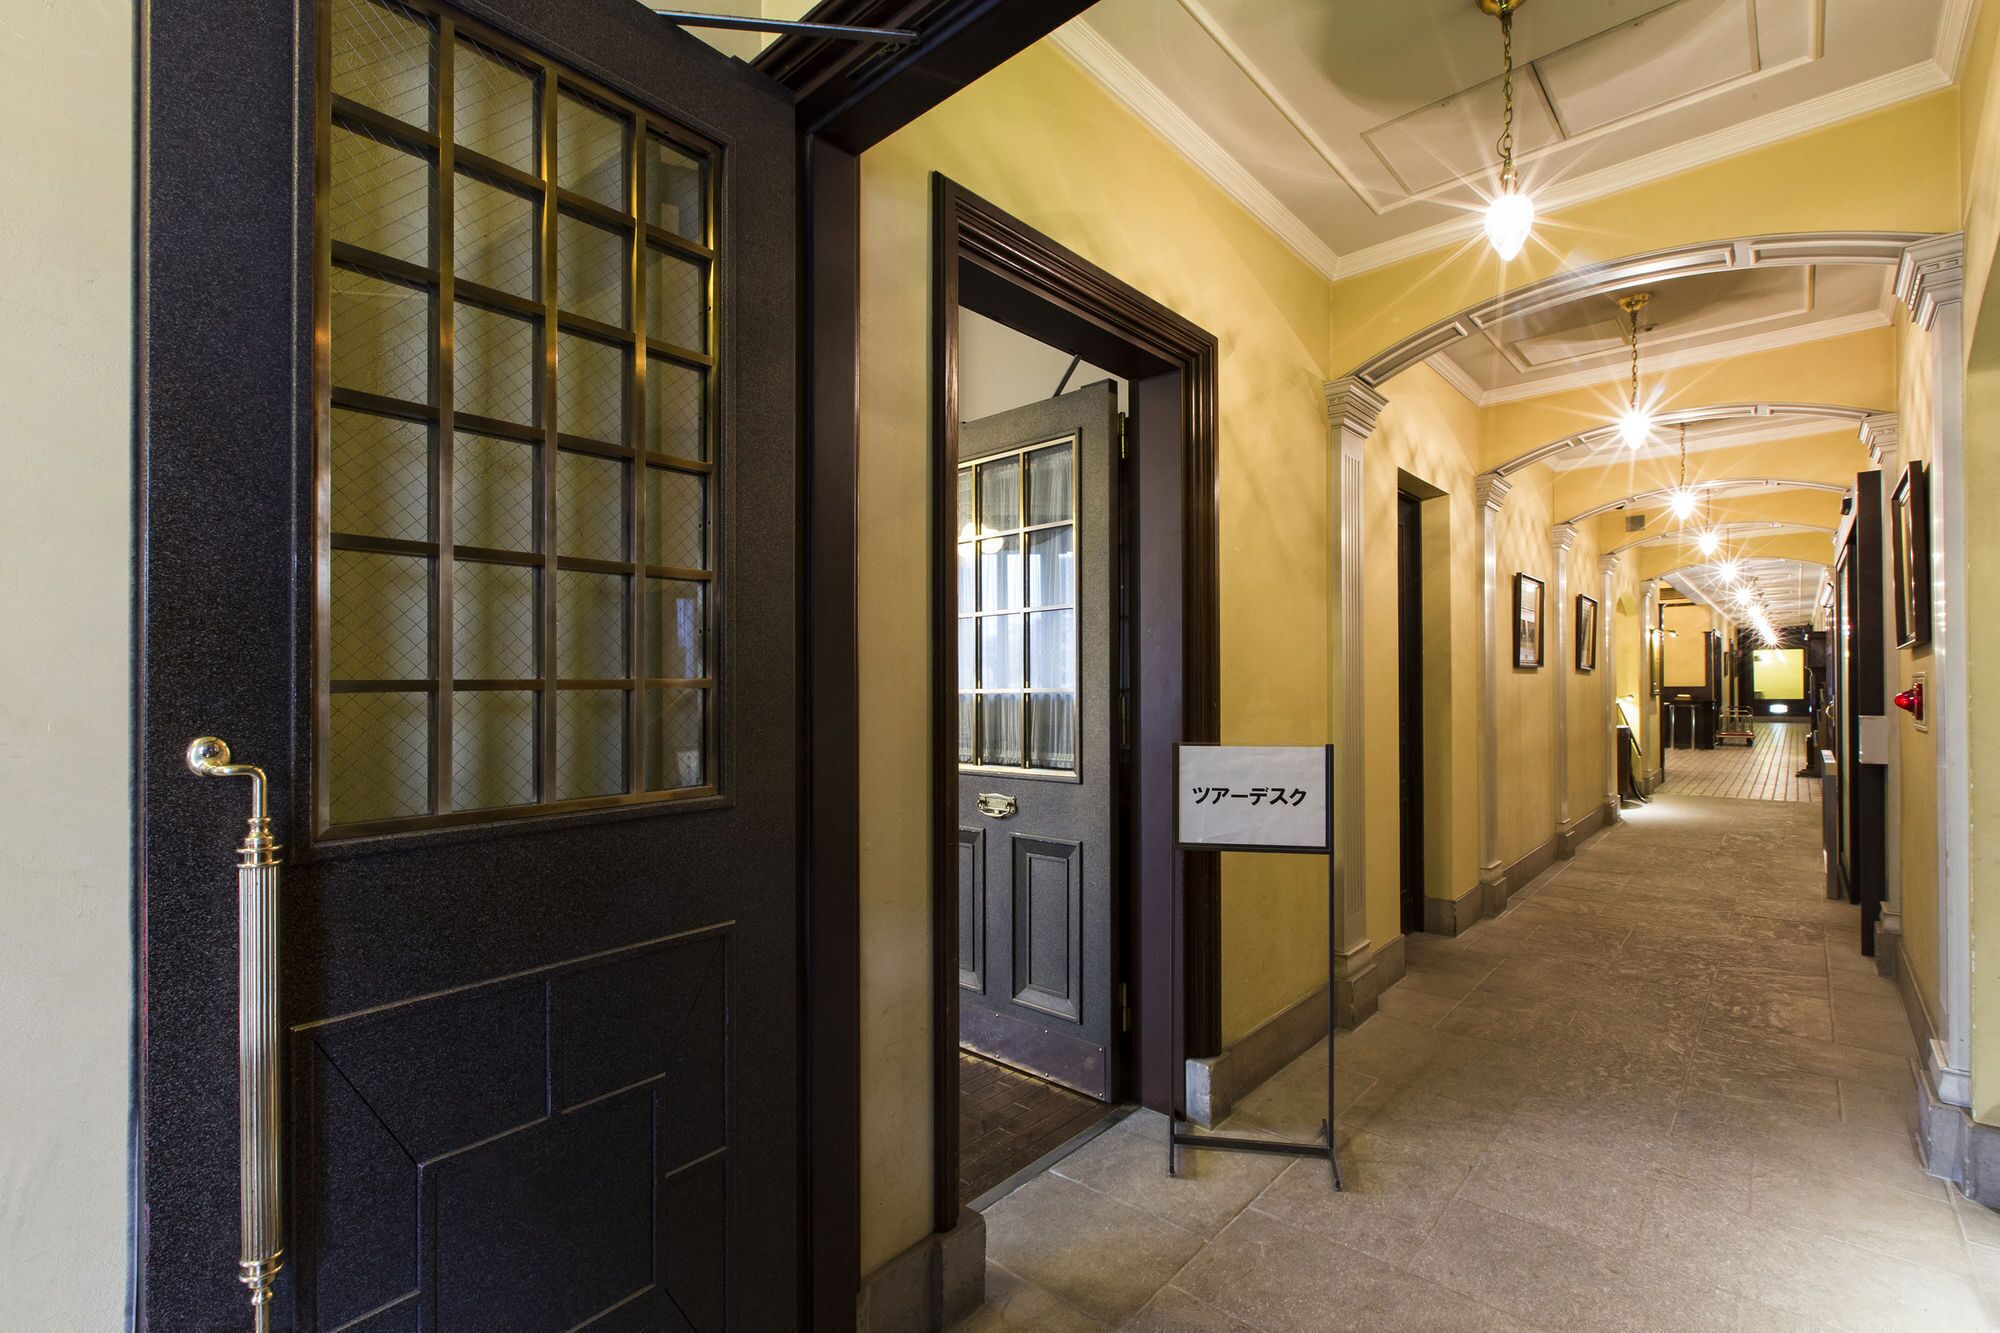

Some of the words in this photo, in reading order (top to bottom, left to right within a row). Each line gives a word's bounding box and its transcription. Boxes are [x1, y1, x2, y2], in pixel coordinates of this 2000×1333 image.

[1192, 786, 1307, 807] ツアーデスク
